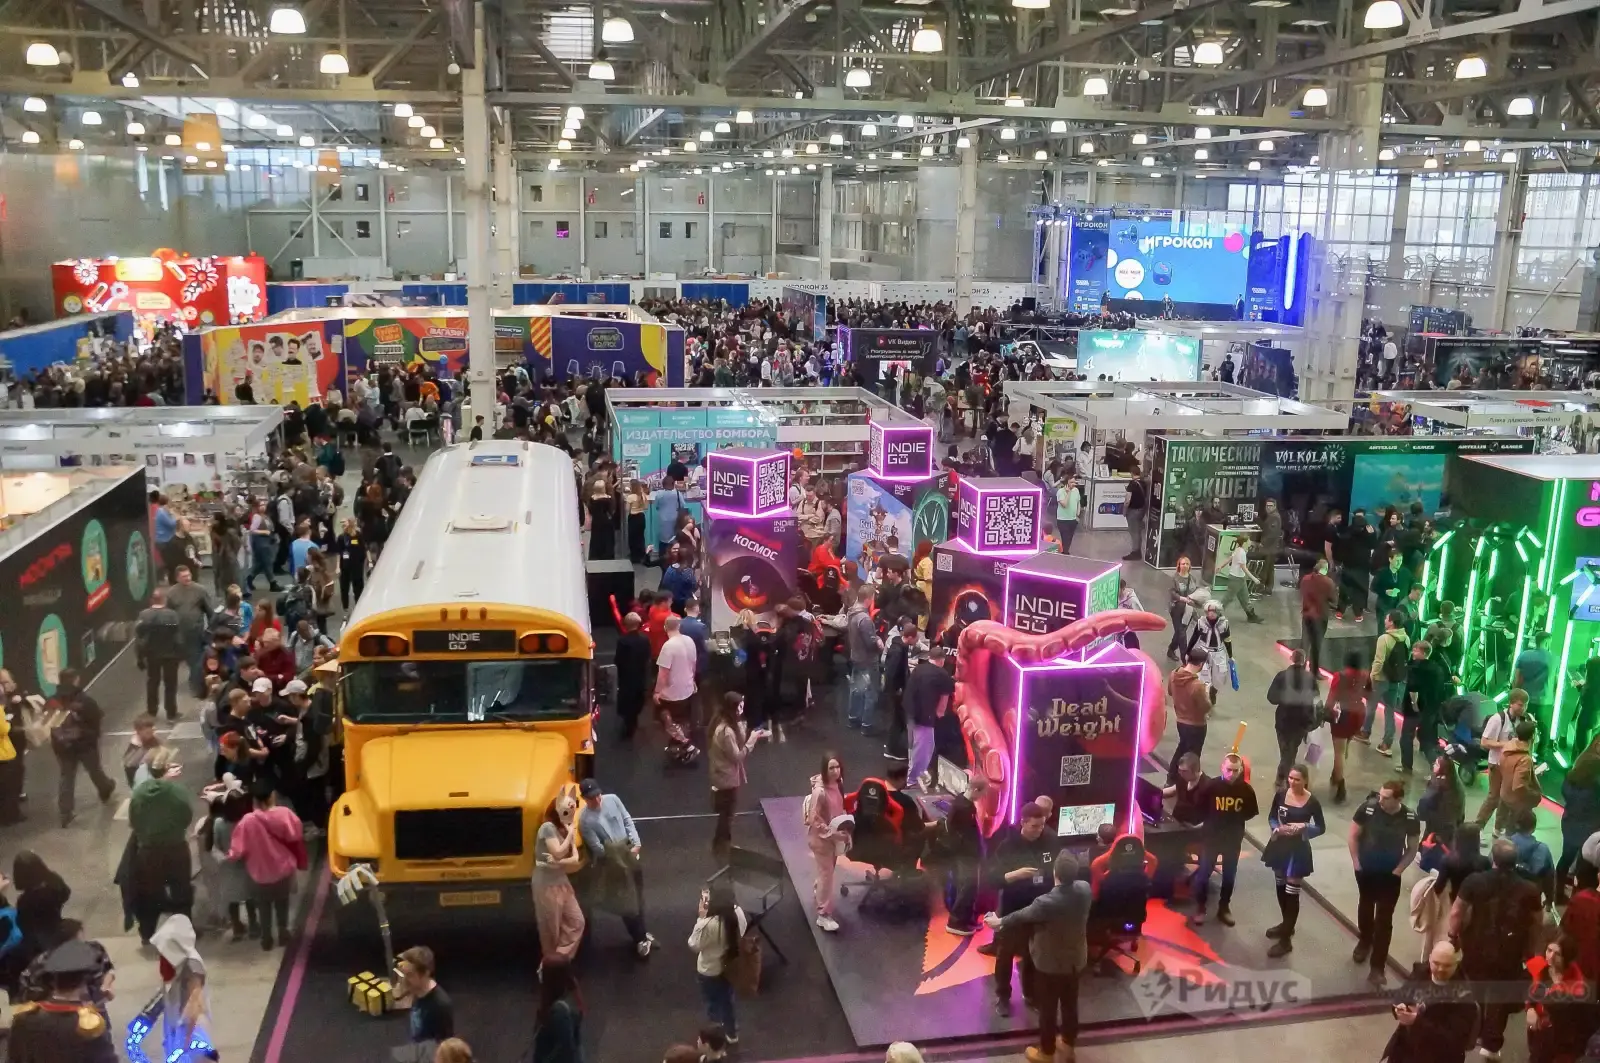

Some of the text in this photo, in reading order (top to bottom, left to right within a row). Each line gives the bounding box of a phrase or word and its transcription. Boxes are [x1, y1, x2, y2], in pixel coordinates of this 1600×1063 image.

[1075, 221, 1108, 229] ИГРОКОН
[1144, 235, 1213, 249] ИГРОКОН
[626, 428, 771, 441] ИЗДАТЕЛЬСТВО БОМБОРА
[888, 442, 926, 453] INDIE
[1171, 445, 1261, 463] ТАКТИЧЕСКИЙ
[1275, 449, 1339, 464] VOLKOLAK
[713, 471, 750, 487] INDIE
[1191, 477, 1259, 498] ЭКШЕН
[732, 533, 778, 561] КОСМОС
[1015, 594, 1077, 621] INDIE
[1014, 612, 1047, 634] GO
[448, 632, 480, 642] INDIE
[1051, 695, 1109, 716] Dead
[1036, 714, 1122, 740] Weight
[1215, 796, 1244, 812] NPC
